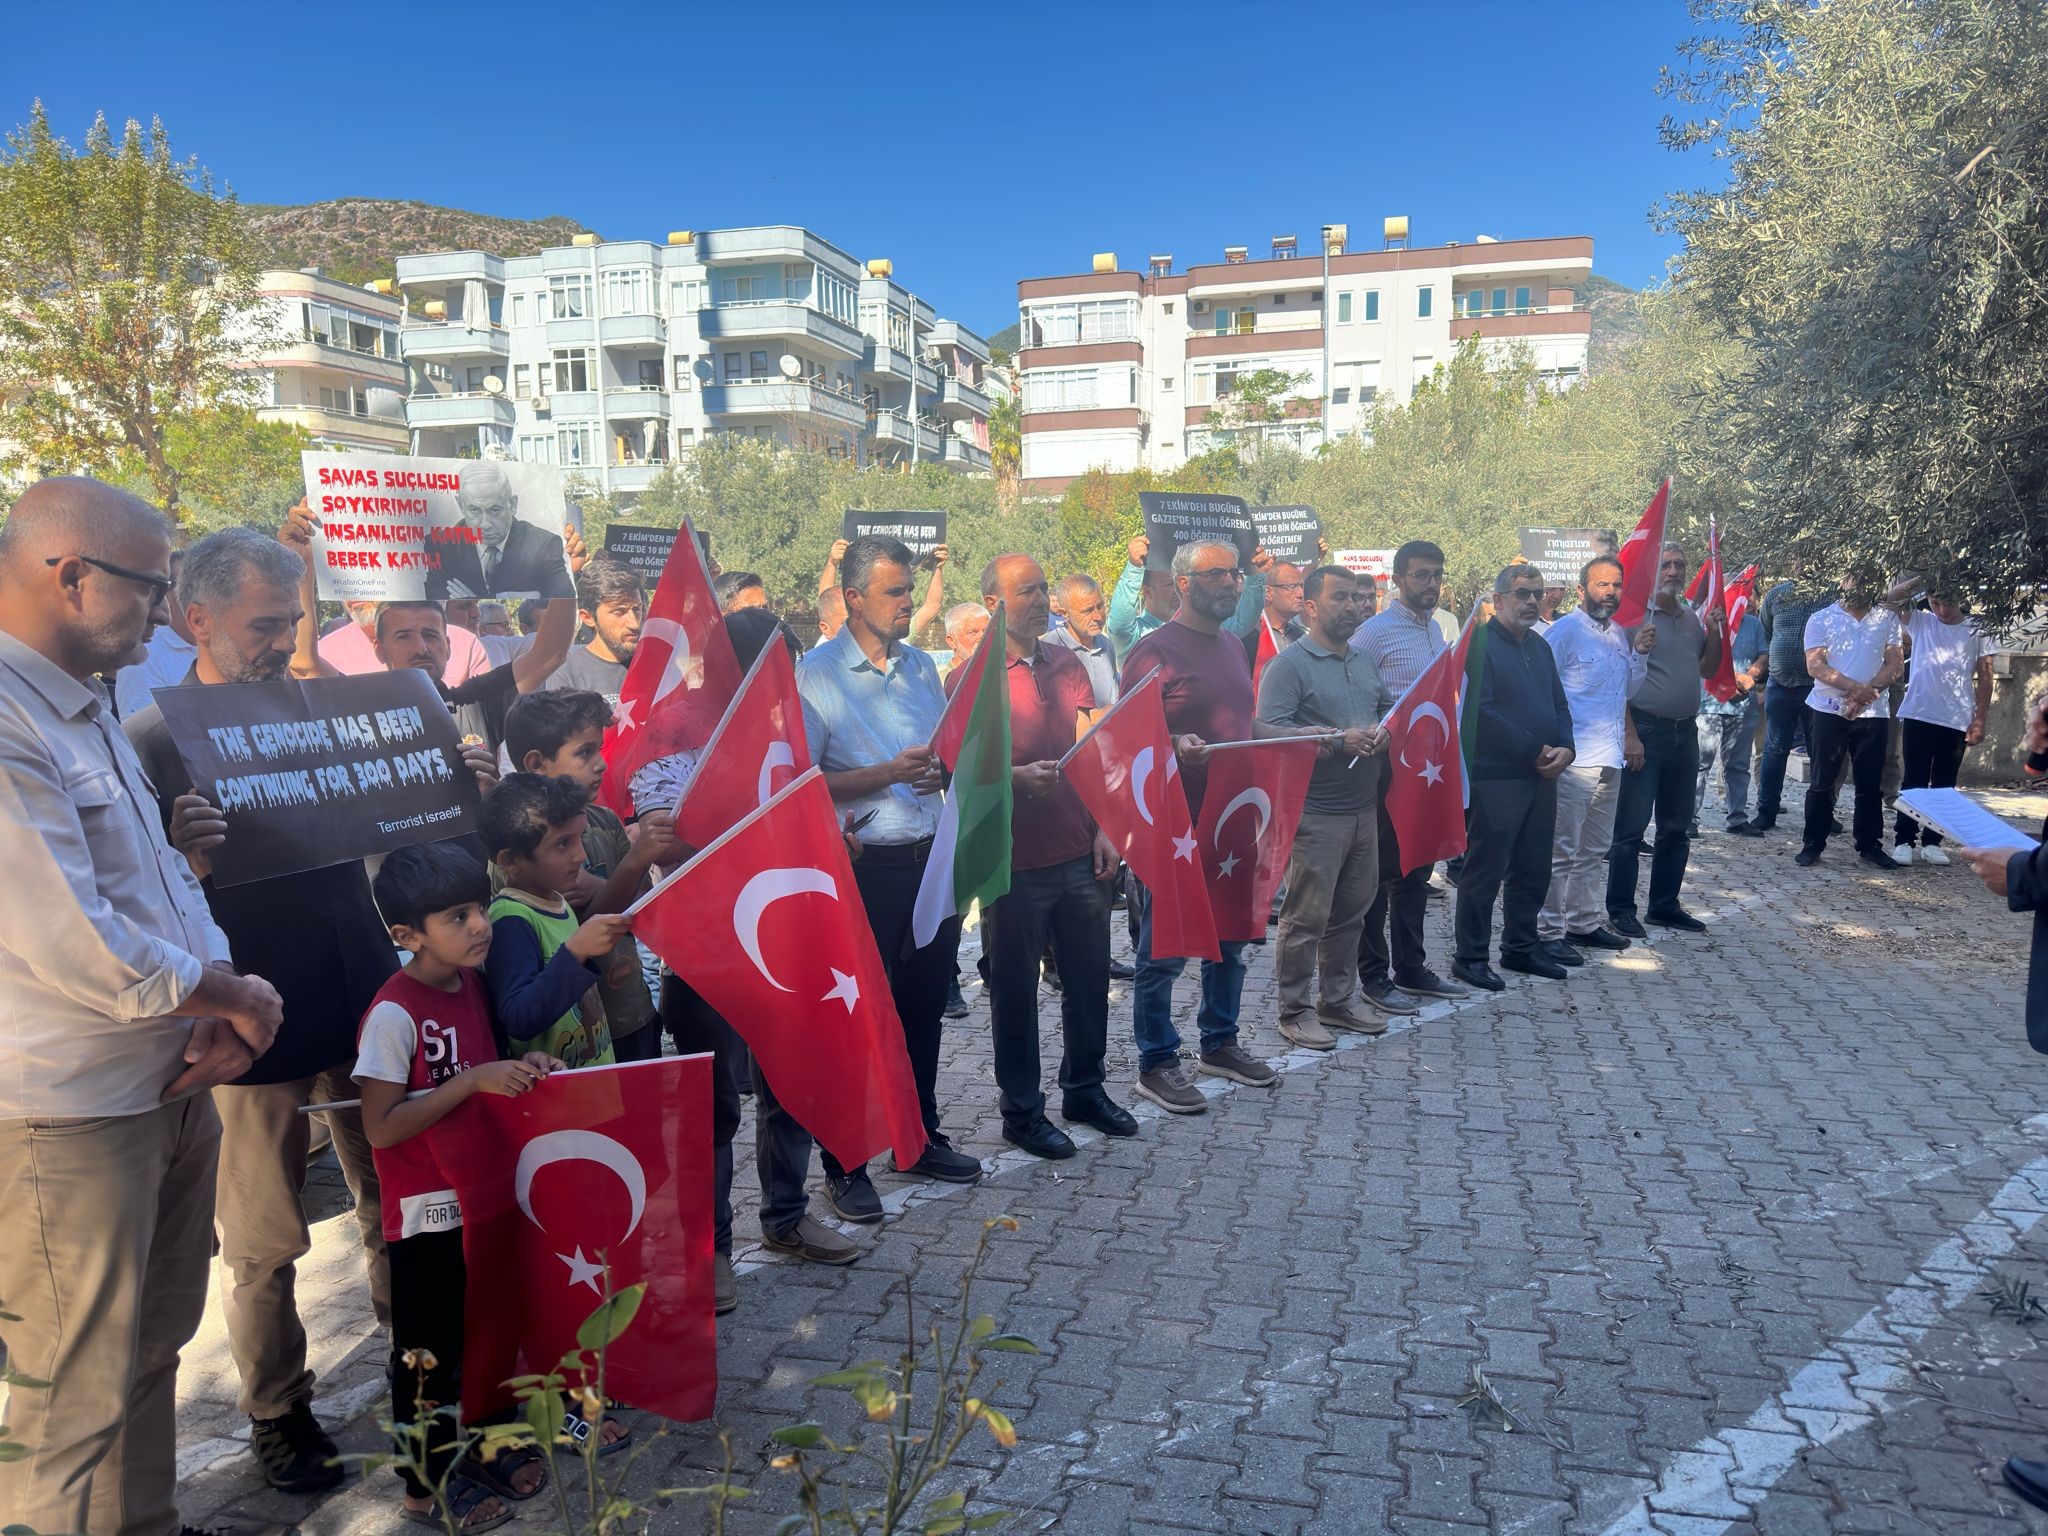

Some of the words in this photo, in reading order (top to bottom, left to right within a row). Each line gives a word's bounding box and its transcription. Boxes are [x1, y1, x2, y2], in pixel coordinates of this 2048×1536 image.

[384, 471, 460, 494] SUÇLUSU
[321, 495, 428, 518] SOYKIRIMCI
[1160, 500, 1165, 510] 7
[1166, 499, 1207, 512] EKİM'DEN
[1209, 501, 1242, 515] BUGÜNE
[1151, 513, 1190, 525] GAZZE'DE
[1190, 517, 1201, 527] 10
[1202, 515, 1218, 527] BİN
[1220, 515, 1252, 530] ÖĞRENCİ
[1282, 510, 1308, 520] BUGÜNE
[857, 524, 871, 538] THE
[871, 524, 902, 538] GENOCIDE
[903, 525, 919, 540] HAS
[920, 525, 937, 539] BEEN
[1269, 524, 1277, 533] 10
[1278, 521, 1290, 532] BİN
[1290, 519, 1318, 531] ÖĞRENCİ
[430, 526, 483, 546] KATILI
[622, 532, 629, 541] 7
[629, 531, 665, 543] EKİM'DEN
[1173, 530, 1189, 540] 400
[1191, 529, 1233, 543] ÖĞRETMEN
[1267, 534, 1302, 545] ÖĞRETMEN
[611, 543, 647, 554] GAZZE'DE
[647, 546, 657, 554] 10
[1545, 549, 1581, 559] ÖĞRETMEN
[1582, 550, 1597, 559] 400
[326, 550, 382, 571] BEBEK
[386, 550, 442, 572] KATILI
[629, 556, 644, 565] 400
[1559, 561, 1571, 571] BİN
[1541, 572, 1566, 582] BUGÜN
[333, 588, 387, 597] #FreePalestine
[208, 725, 252, 764] THE
[250, 719, 334, 762] GENOCIDE
[331, 713, 379, 751] HAS
[374, 705, 425, 745] BEEN
[215, 769, 320, 815] CONTINUING
[314, 765, 357, 798] FOR
[352, 757, 394, 792] 300
[393, 747, 453, 788] DAYS.
[376, 815, 424, 834] Terrorist
[424, 804, 462, 824] israel#
[427, 1060, 470, 1083] JEANS
[426, 1207, 448, 1224] FOR
